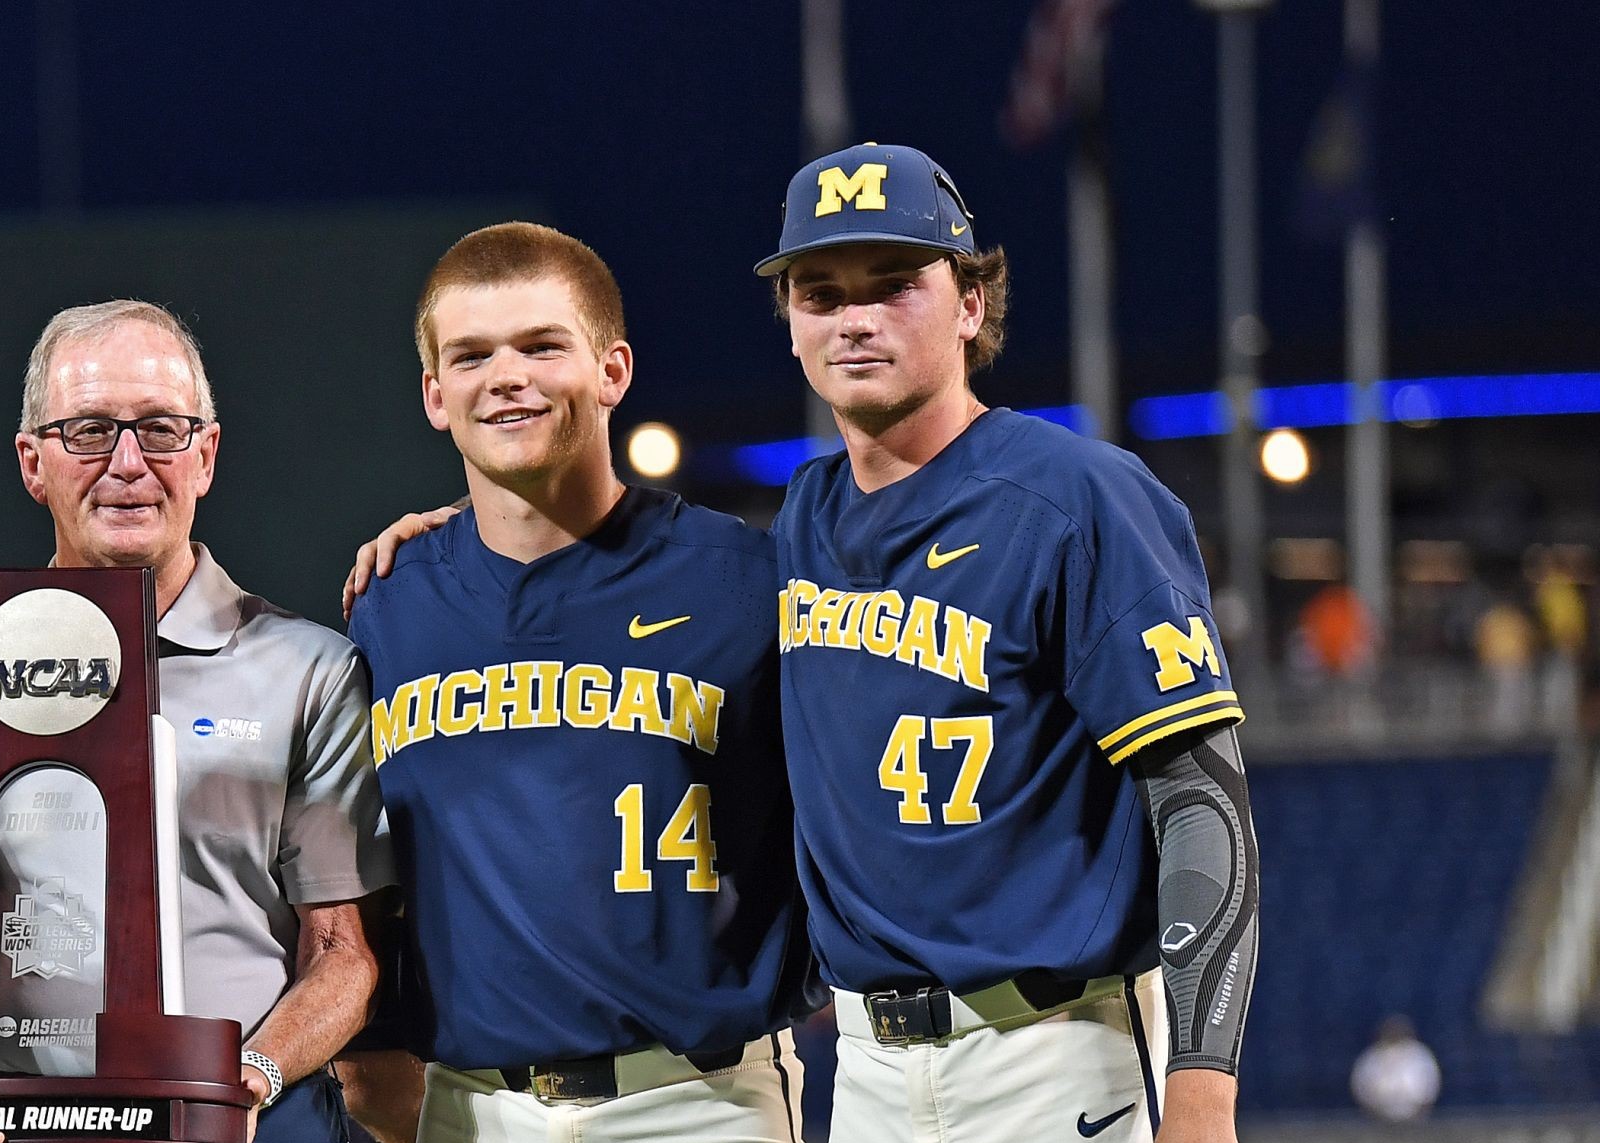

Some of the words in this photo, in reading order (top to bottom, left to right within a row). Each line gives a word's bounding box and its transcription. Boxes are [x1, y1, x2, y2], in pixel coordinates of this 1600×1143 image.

[815, 163, 888, 217] M
[1142, 614, 1222, 692] M
[372, 660, 725, 771] MICHIGAN
[878, 715, 994, 824] 47
[6, 811, 88, 832] DIVISION
[613, 784, 719, 893] 14
[19, 1018, 96, 1035] BASEBALL
[21, 1106, 153, 1132] RUNNER-UP
